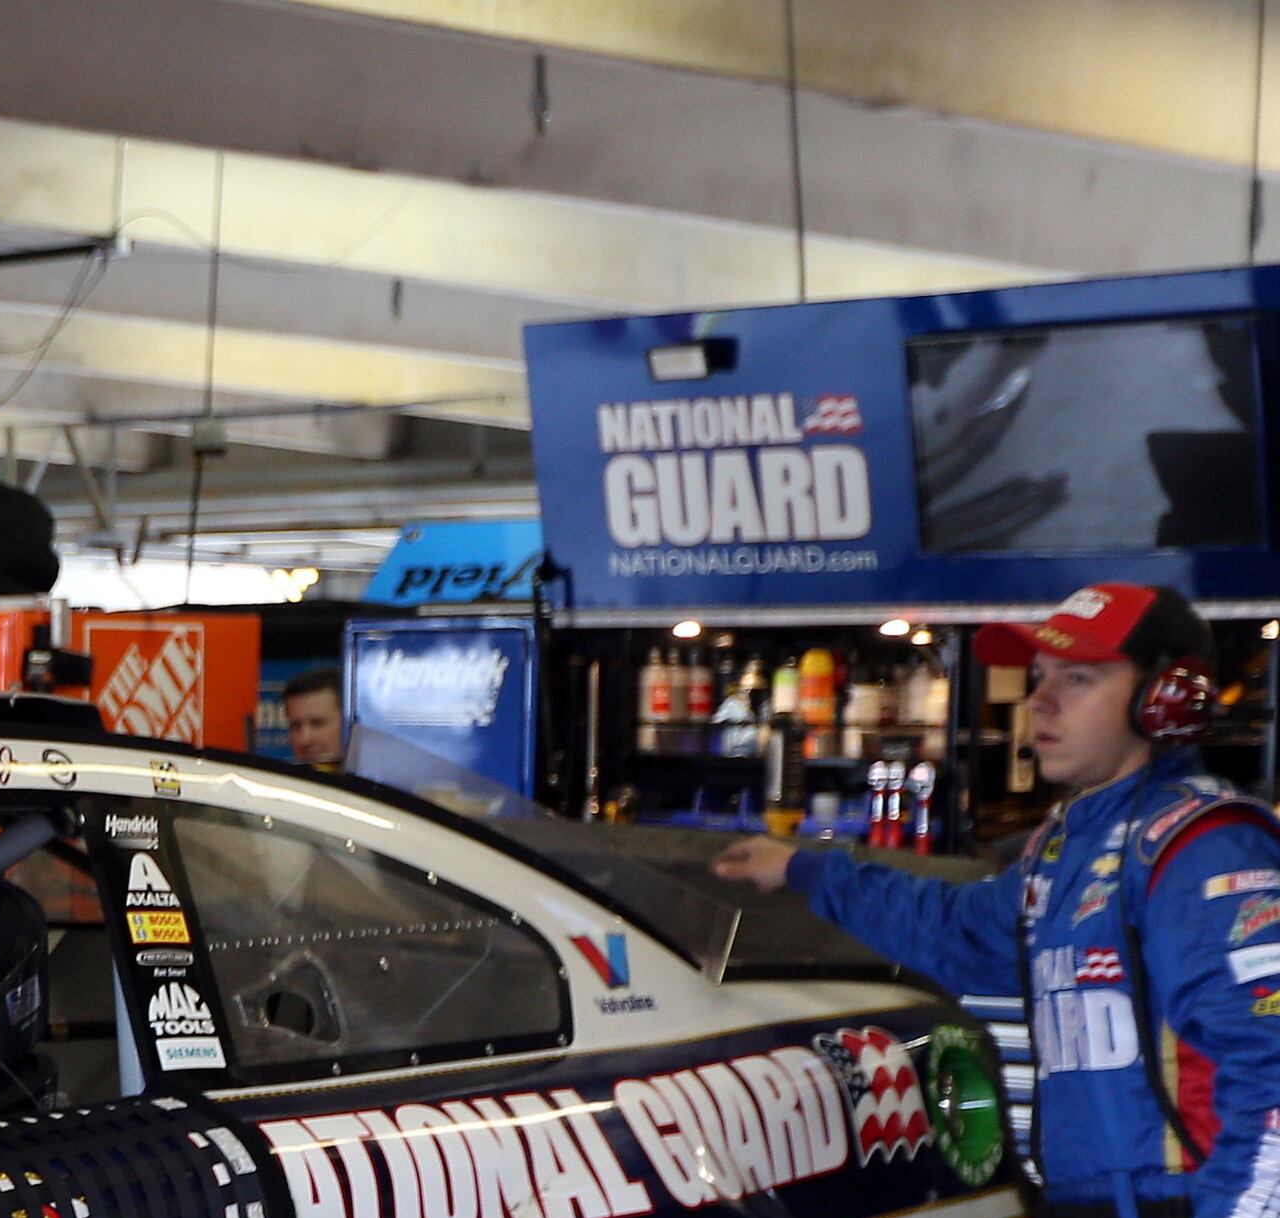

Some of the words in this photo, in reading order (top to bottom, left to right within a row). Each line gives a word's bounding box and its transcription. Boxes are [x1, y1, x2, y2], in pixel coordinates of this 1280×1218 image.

[598, 392, 804, 452] NATIONAL
[604, 444, 872, 549] GUARD
[609, 545, 878, 577] NATIONALGUARD.com
[100, 642, 149, 721] THE
[105, 814, 159, 838] Hendrick
[125, 892, 181, 908] AXALTA
[148, 981, 212, 1022] MAC
[150, 1020, 216, 1036] TOOLS
[613, 1046, 850, 1209] GUARD
